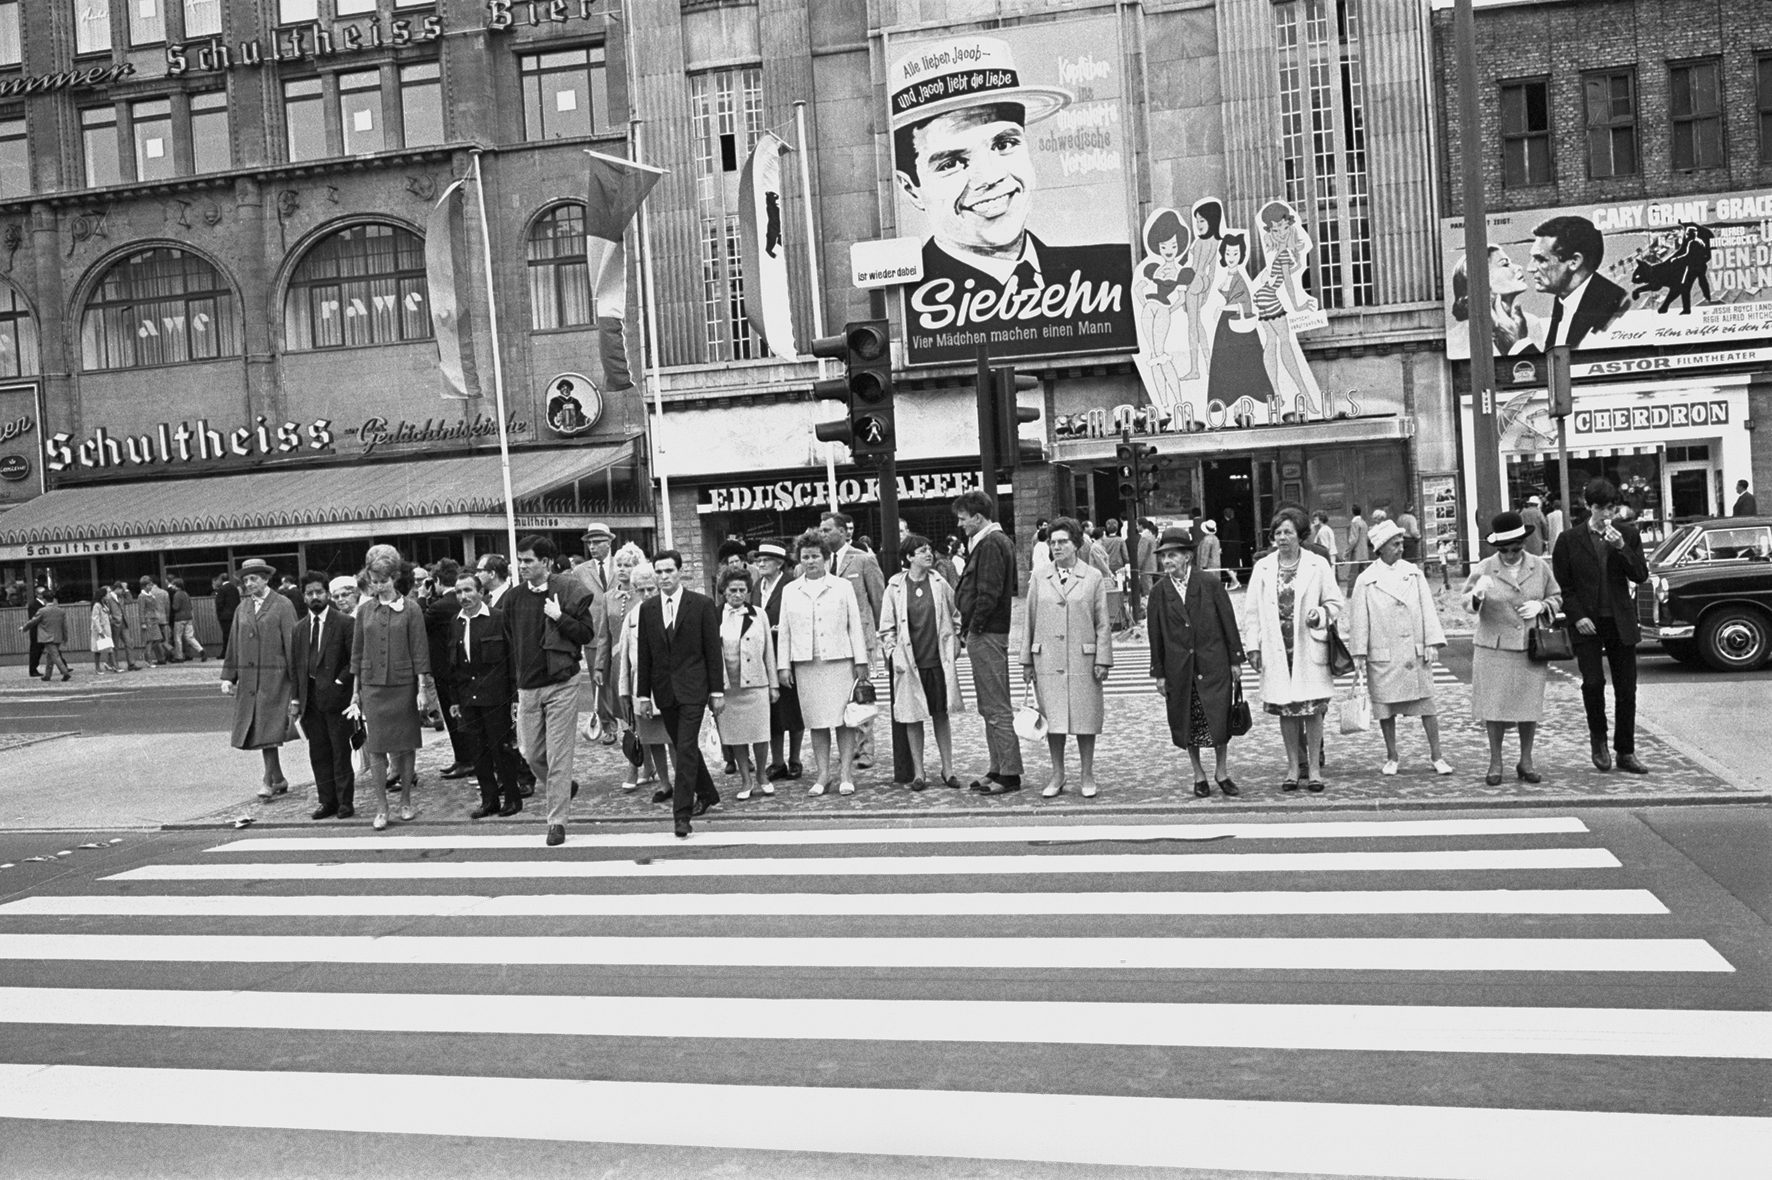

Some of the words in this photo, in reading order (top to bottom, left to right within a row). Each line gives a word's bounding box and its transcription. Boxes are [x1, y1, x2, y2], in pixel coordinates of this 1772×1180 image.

[166, 15, 444, 76] Schultheiss
[488, 0, 593, 30] Bier
[903, 61, 921, 79] Alle
[921, 51, 951, 71] lieben
[897, 88, 916, 109] und
[918, 79, 944, 103] Jacob
[947, 74, 968, 94] liebt
[971, 72, 983, 89] die
[1039, 126, 1111, 153] schwedische
[1592, 204, 1644, 231] CARY
[1647, 200, 1709, 227] GRANT
[1716, 194, 1772, 220] GRACE
[1710, 246, 1751, 270] DEN
[1756, 245, 1772, 267] D
[857, 271, 868, 282] ist
[868, 268, 897, 281] wieder
[896, 265, 918, 278] dabei
[1709, 268, 1752, 291] VON
[910, 269, 1123, 330] Siebzehn
[1711, 305, 1731, 315] JESSIE
[1733, 304, 1753, 314] ROYCE
[1722, 313, 1745, 323] ALFRED
[912, 335, 934, 349] Vier
[936, 331, 987, 347] Mädchen
[990, 327, 1038, 343] machen
[1042, 324, 1073, 338] einen
[1078, 320, 1112, 335] Mann
[1655, 327, 1682, 338] Film
[1587, 357, 1671, 375] ASTOR
[1676, 351, 1757, 366] FILMTHEATER
[1086, 388, 1361, 439] MARMORHAUS
[1576, 402, 1728, 432] CHERDRON
[46, 415, 333, 472] Schultheiss
[26, 540, 131, 557] Schultheiss
